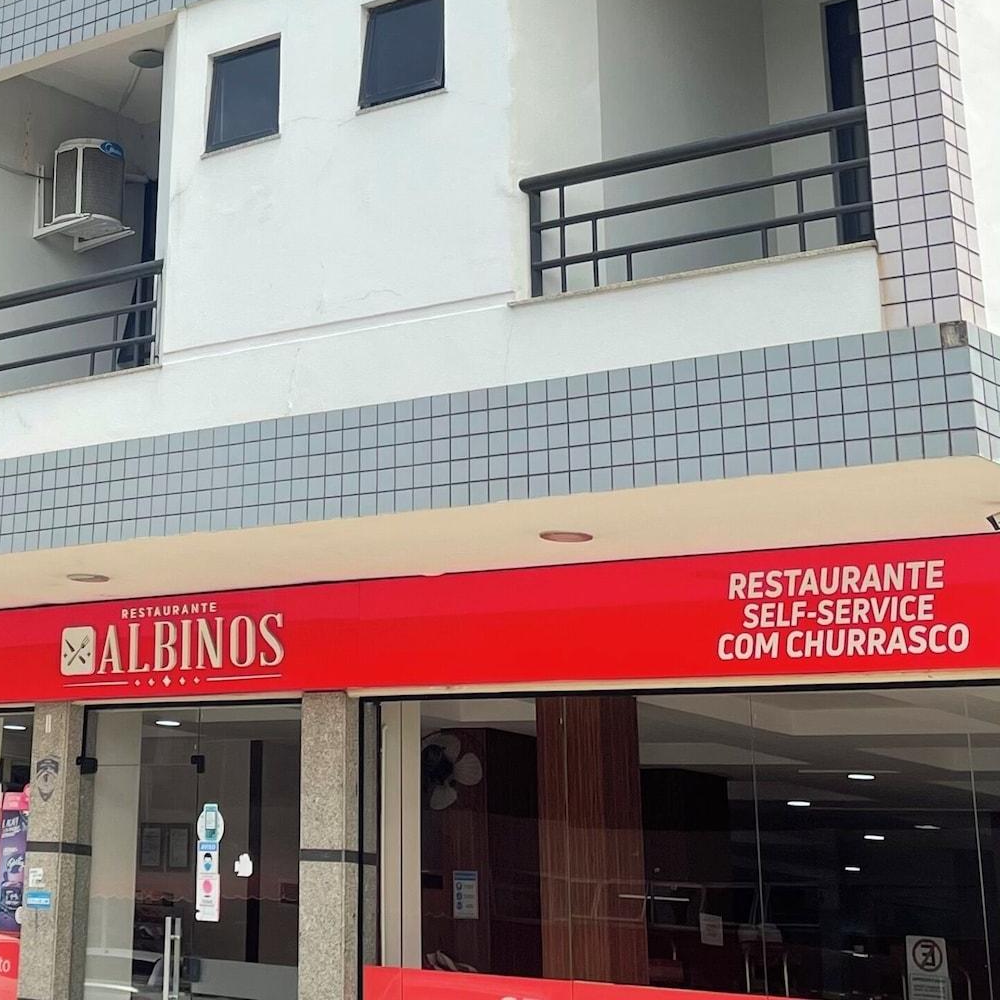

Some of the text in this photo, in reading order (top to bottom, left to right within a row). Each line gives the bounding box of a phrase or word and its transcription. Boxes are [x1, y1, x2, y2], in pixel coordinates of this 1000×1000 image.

[728, 559, 945, 600] RESTAURANTE
[121, 601, 218, 620] RESTAURANTE
[742, 594, 935, 629] SELF-SERVICE
[96, 612, 285, 675] ALBINOS
[717, 623, 970, 661] COM CHURRASCO
